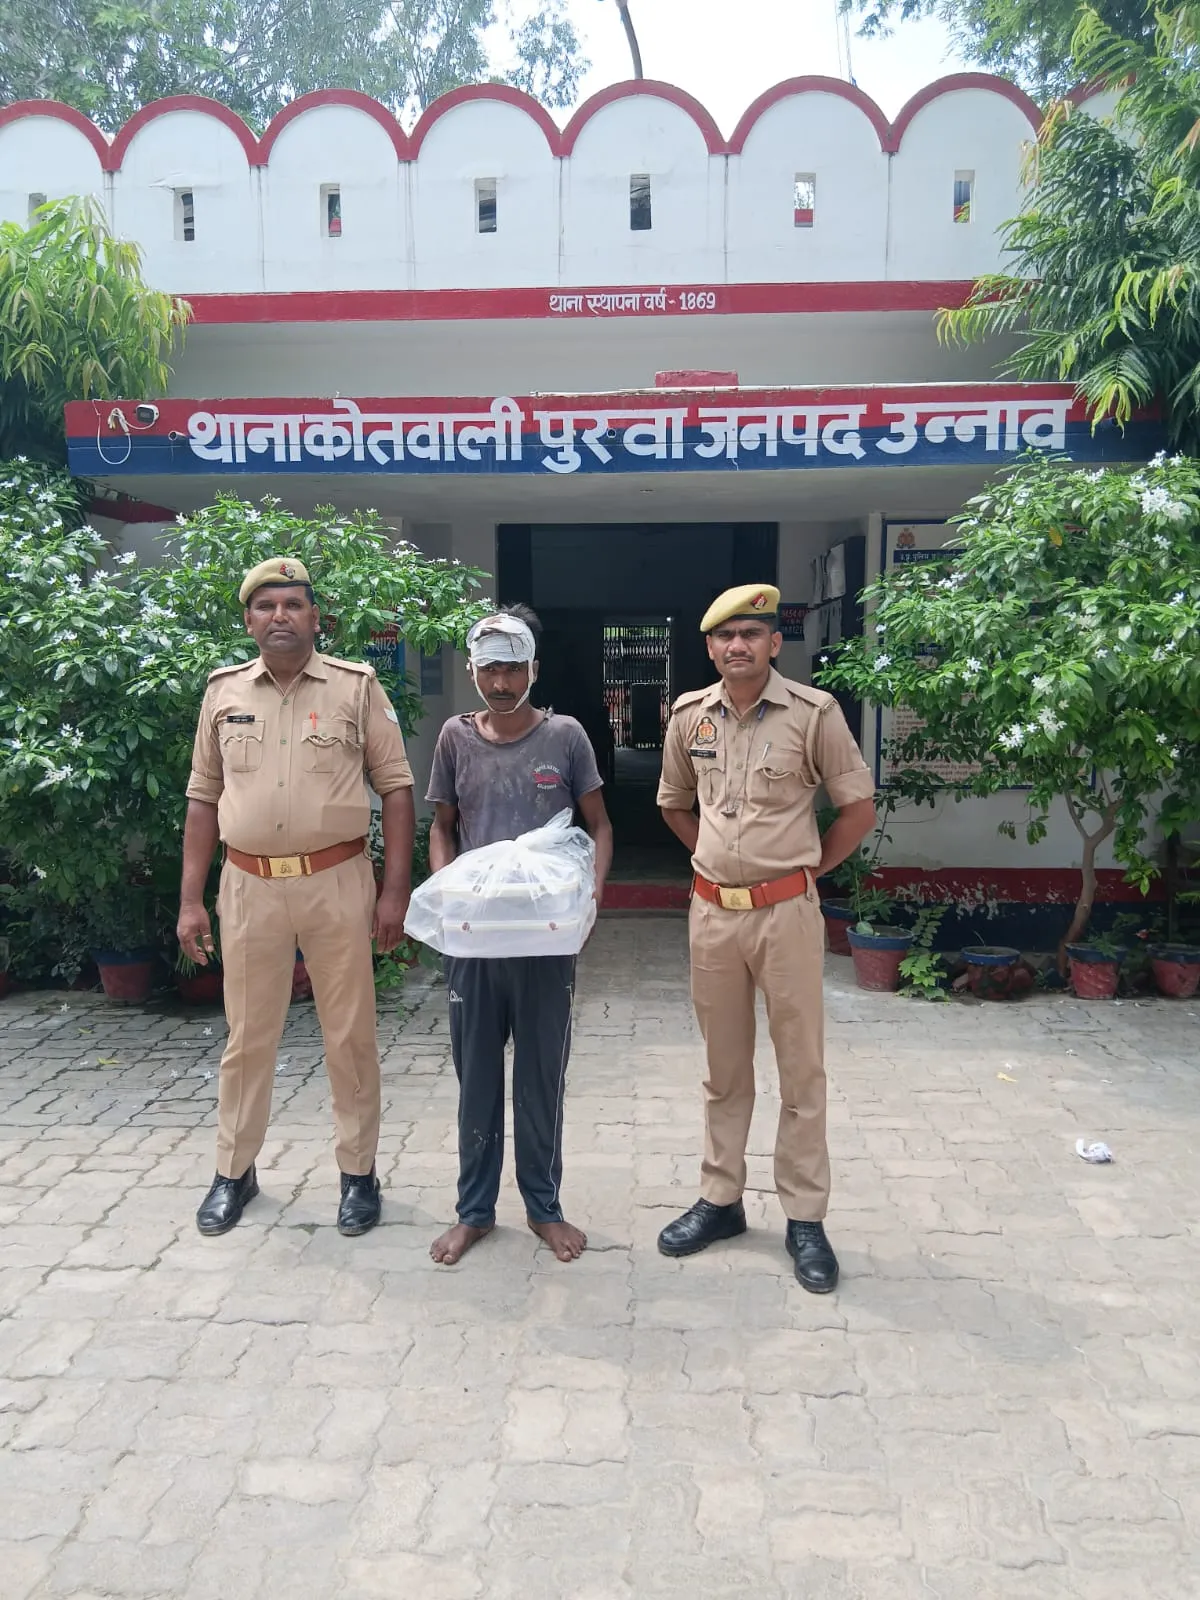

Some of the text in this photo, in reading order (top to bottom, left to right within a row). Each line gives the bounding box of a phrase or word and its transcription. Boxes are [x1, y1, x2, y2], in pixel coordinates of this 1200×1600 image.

[549, 294, 583, 313] थाना
[585, 293, 641, 315] स्थापना
[642, 287, 667, 311] वर्ष
[679, 291, 716, 311] 1869
[533, 407, 688, 474] पुरवा
[693, 403, 867, 460] जनपद
[875, 398, 1073, 455] उन्नाव
